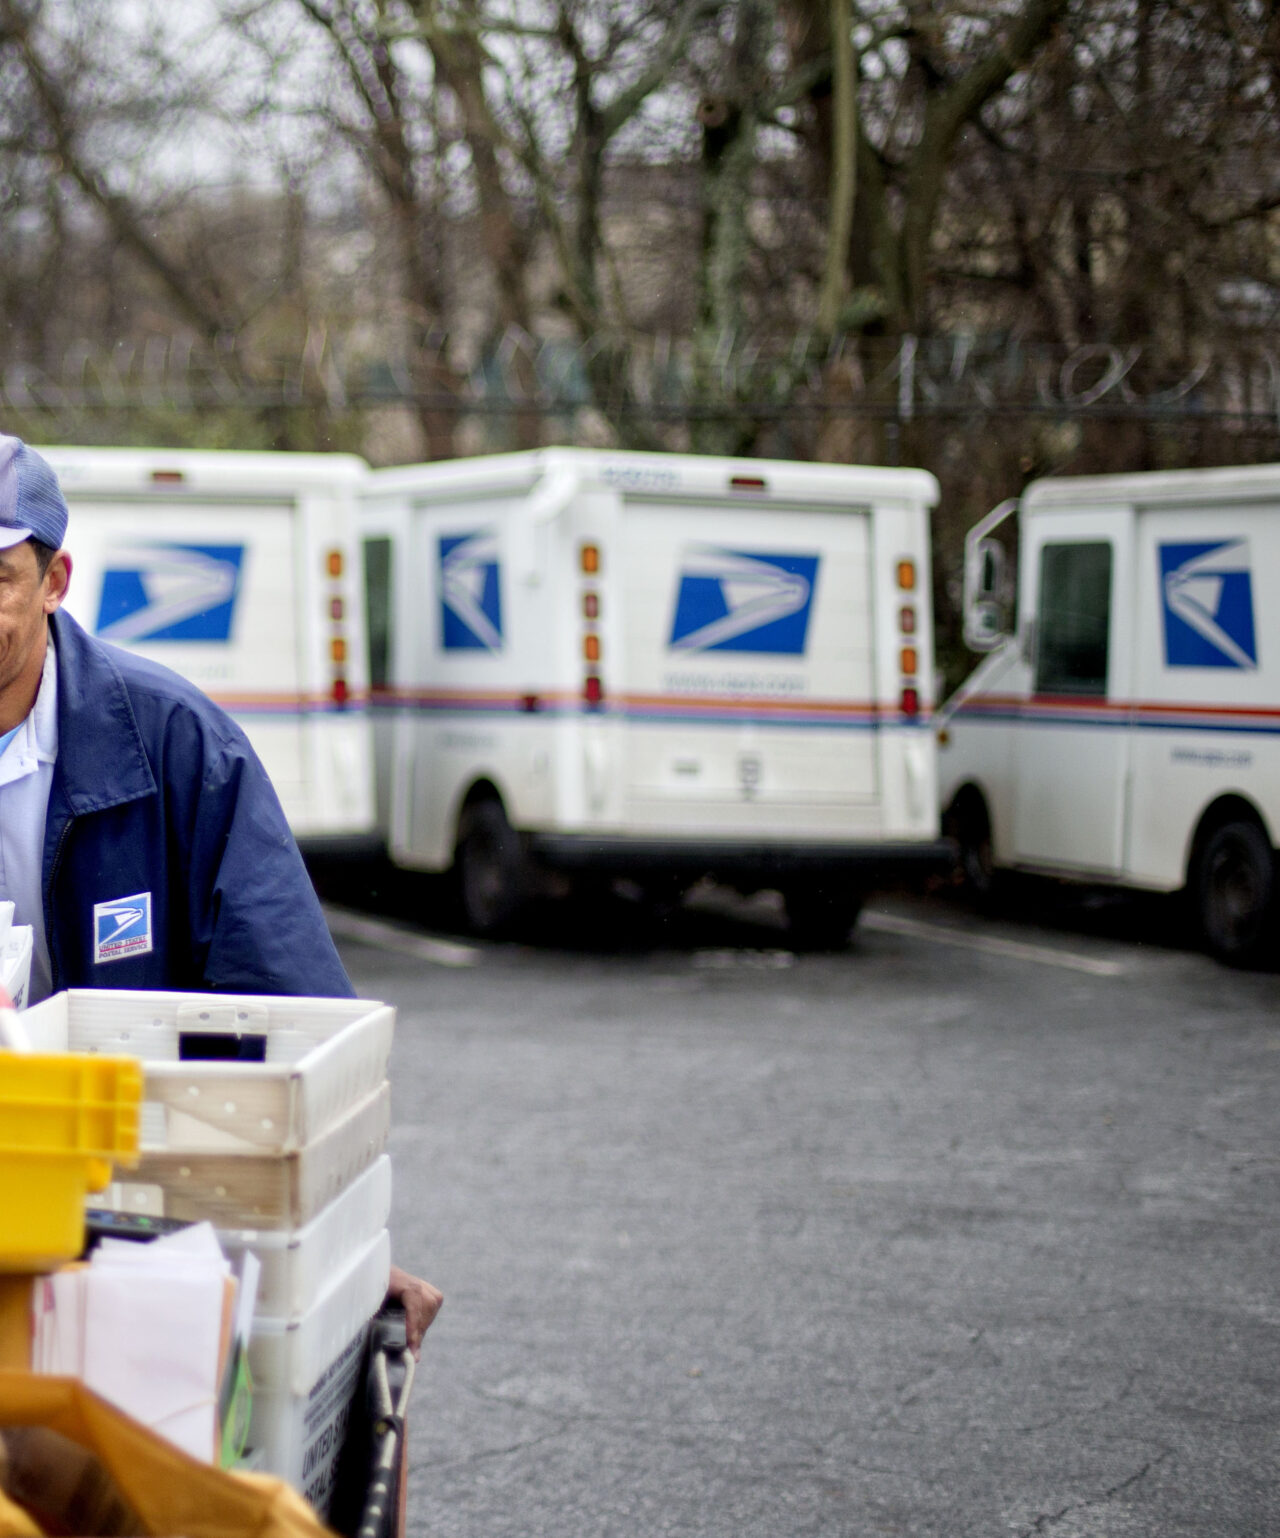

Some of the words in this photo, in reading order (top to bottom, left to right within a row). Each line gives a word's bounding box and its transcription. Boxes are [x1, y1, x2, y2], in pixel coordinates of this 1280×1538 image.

[99, 941, 122, 951] UNITED
[125, 935, 147, 945] STATES
[99, 949, 122, 959] POSTAL
[124, 943, 148, 953] SERVICE
[303, 1422, 333, 1480] UNITED
